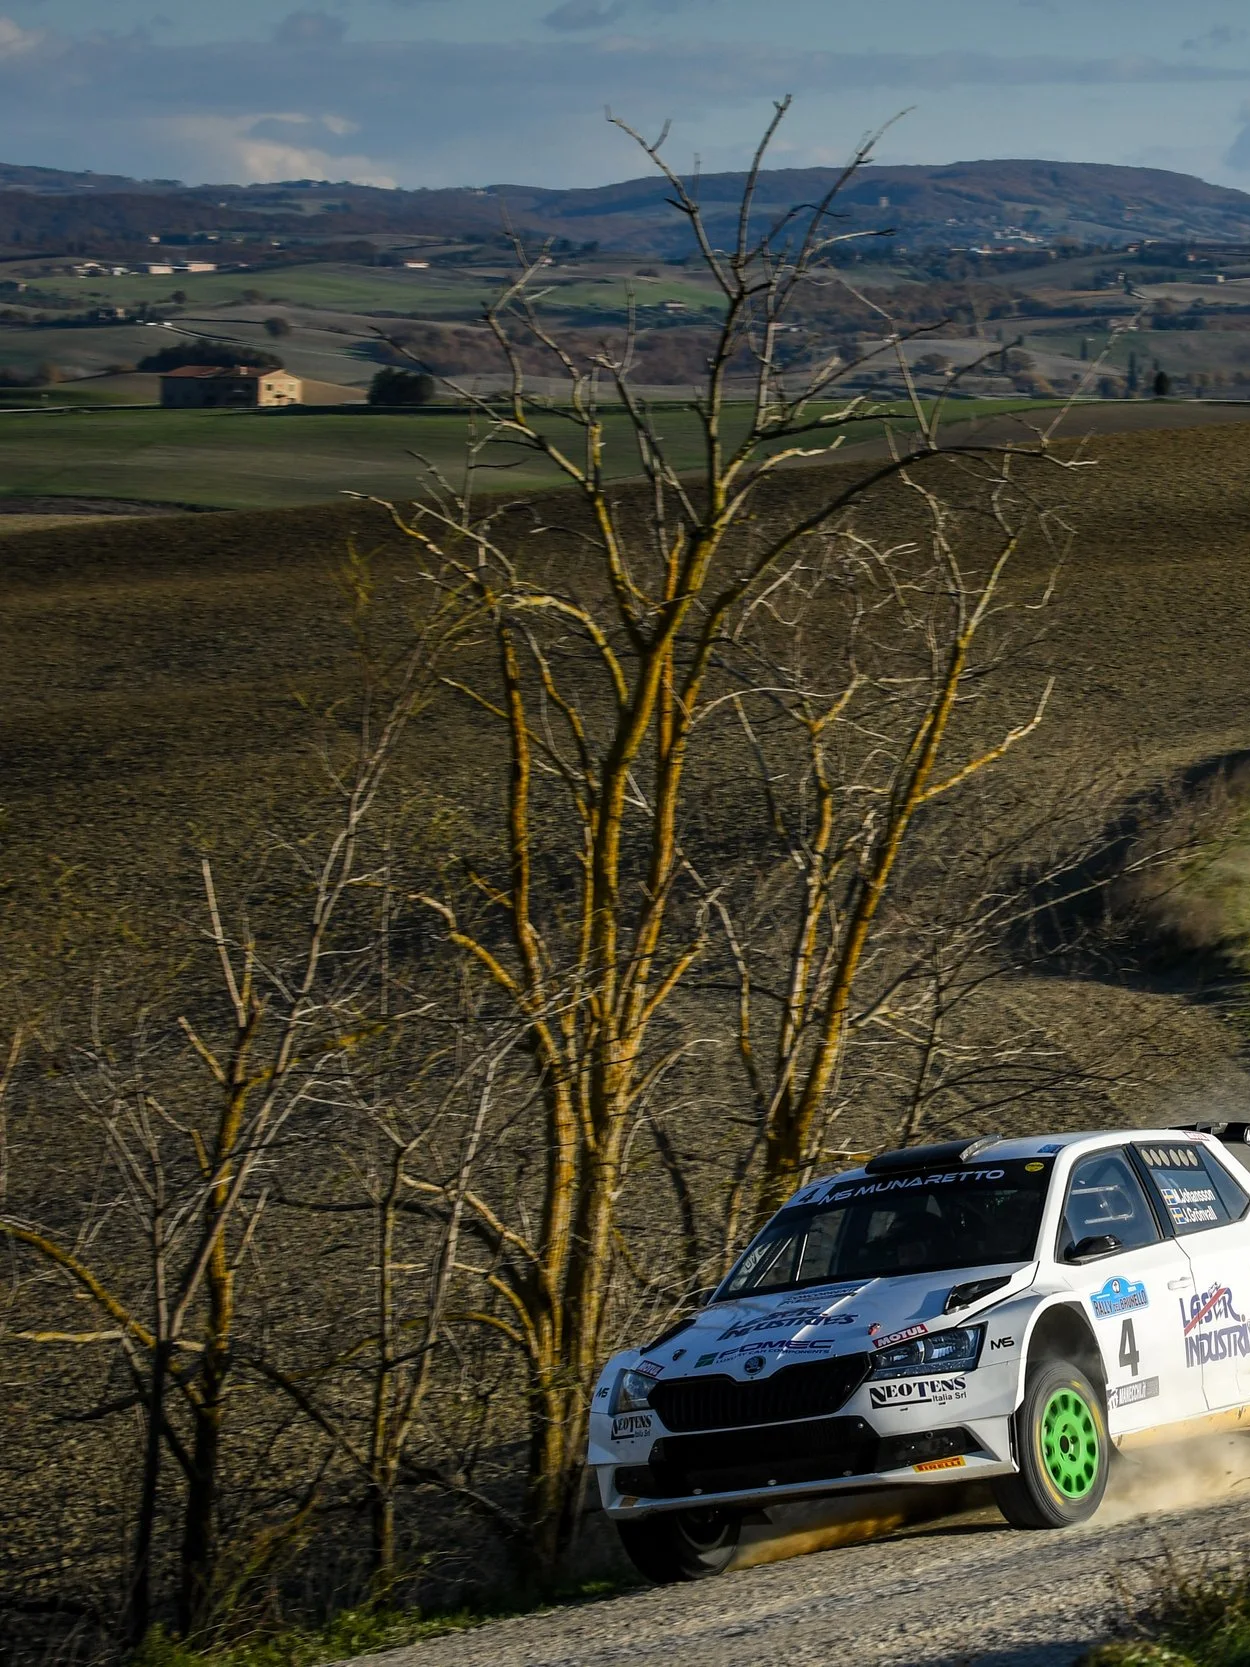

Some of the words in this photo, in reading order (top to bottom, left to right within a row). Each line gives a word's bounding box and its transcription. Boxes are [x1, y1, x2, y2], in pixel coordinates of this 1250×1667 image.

[818, 1189, 853, 1205] MS
[853, 1169, 1005, 1197] MUNARETTO
[1093, 1299, 1112, 1317] RALLY
[1119, 1289, 1148, 1310] BRUNELLO
[1179, 1286, 1241, 1329] LASER
[877, 1325, 926, 1347] MOTUL
[990, 1336, 1015, 1350] MS
[1119, 1318, 1139, 1376] 4
[718, 1339, 836, 1359] FOMEC
[748, 1348, 769, 1356] CAR
[769, 1347, 831, 1355] COMPONENTS
[869, 1376, 967, 1403] NEOTENS
[932, 1391, 953, 1403] Italia
[954, 1390, 967, 1400] Srl
[613, 1414, 653, 1436] NEOTENS
